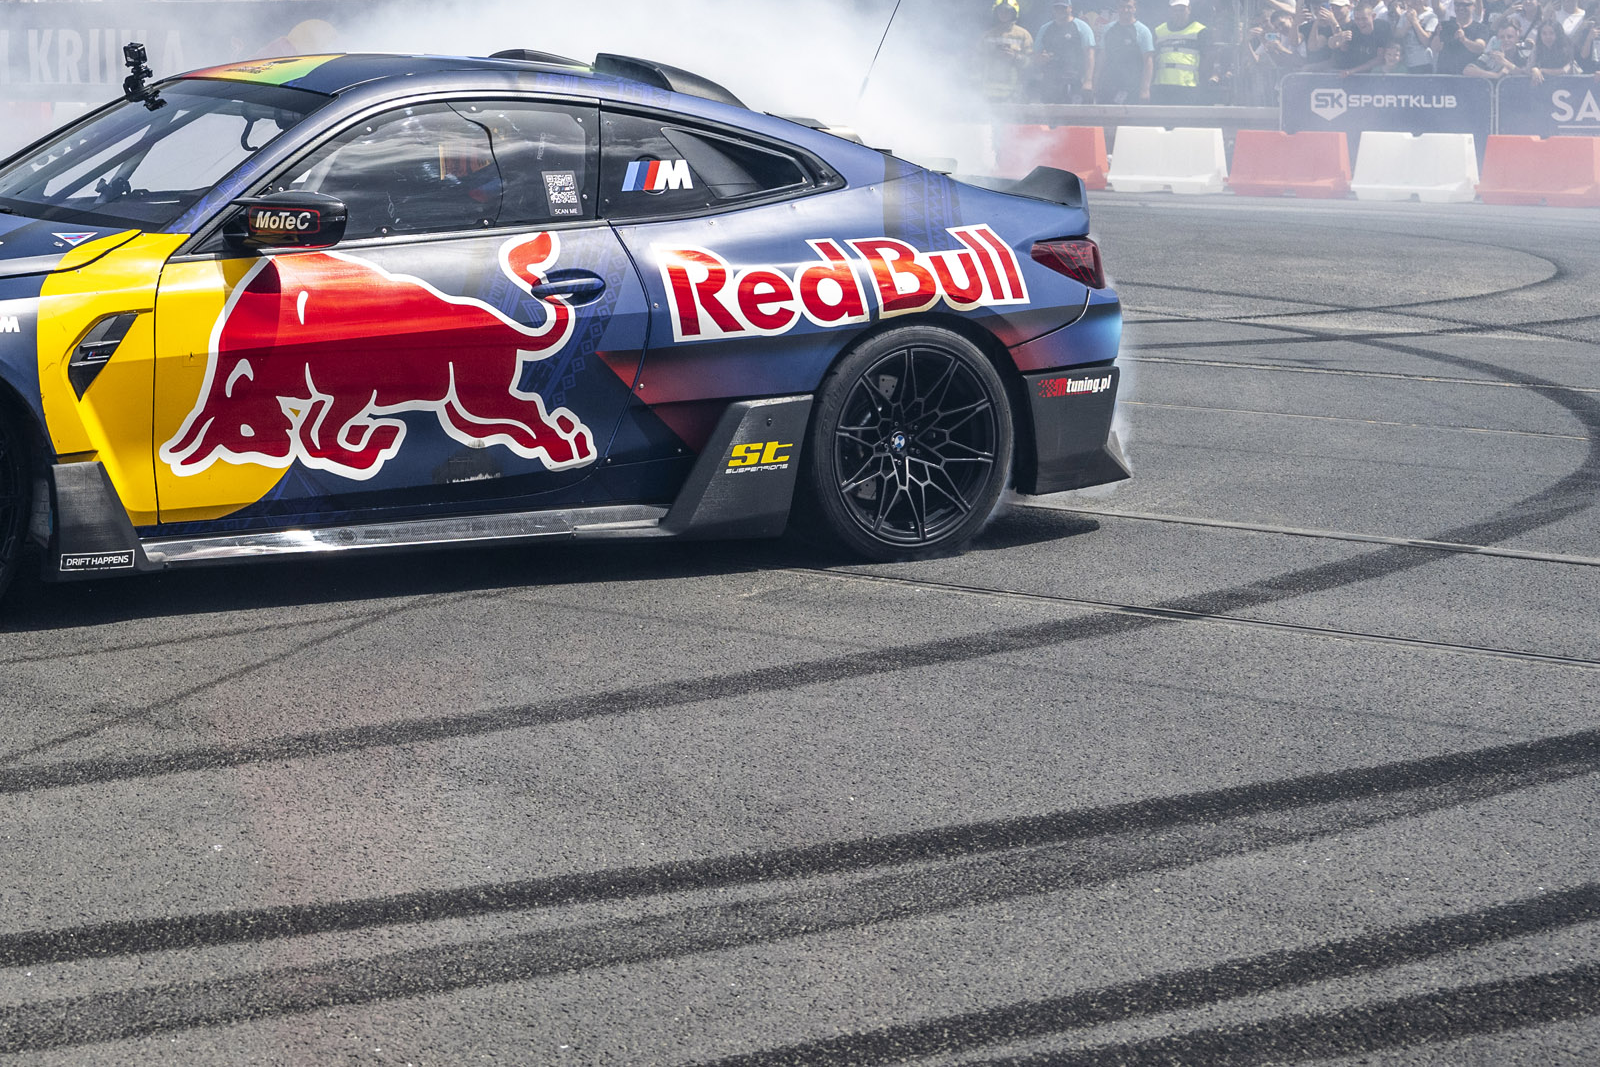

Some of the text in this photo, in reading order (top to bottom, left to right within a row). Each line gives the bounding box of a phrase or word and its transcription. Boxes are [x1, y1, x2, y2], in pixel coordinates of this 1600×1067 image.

[1348, 94, 1458, 108] SPORTKLUB
[255, 210, 312, 231] MoTeC
[653, 226, 1028, 339] Red Bull
[66, 555, 129, 566] DRIFT HAPPENS
